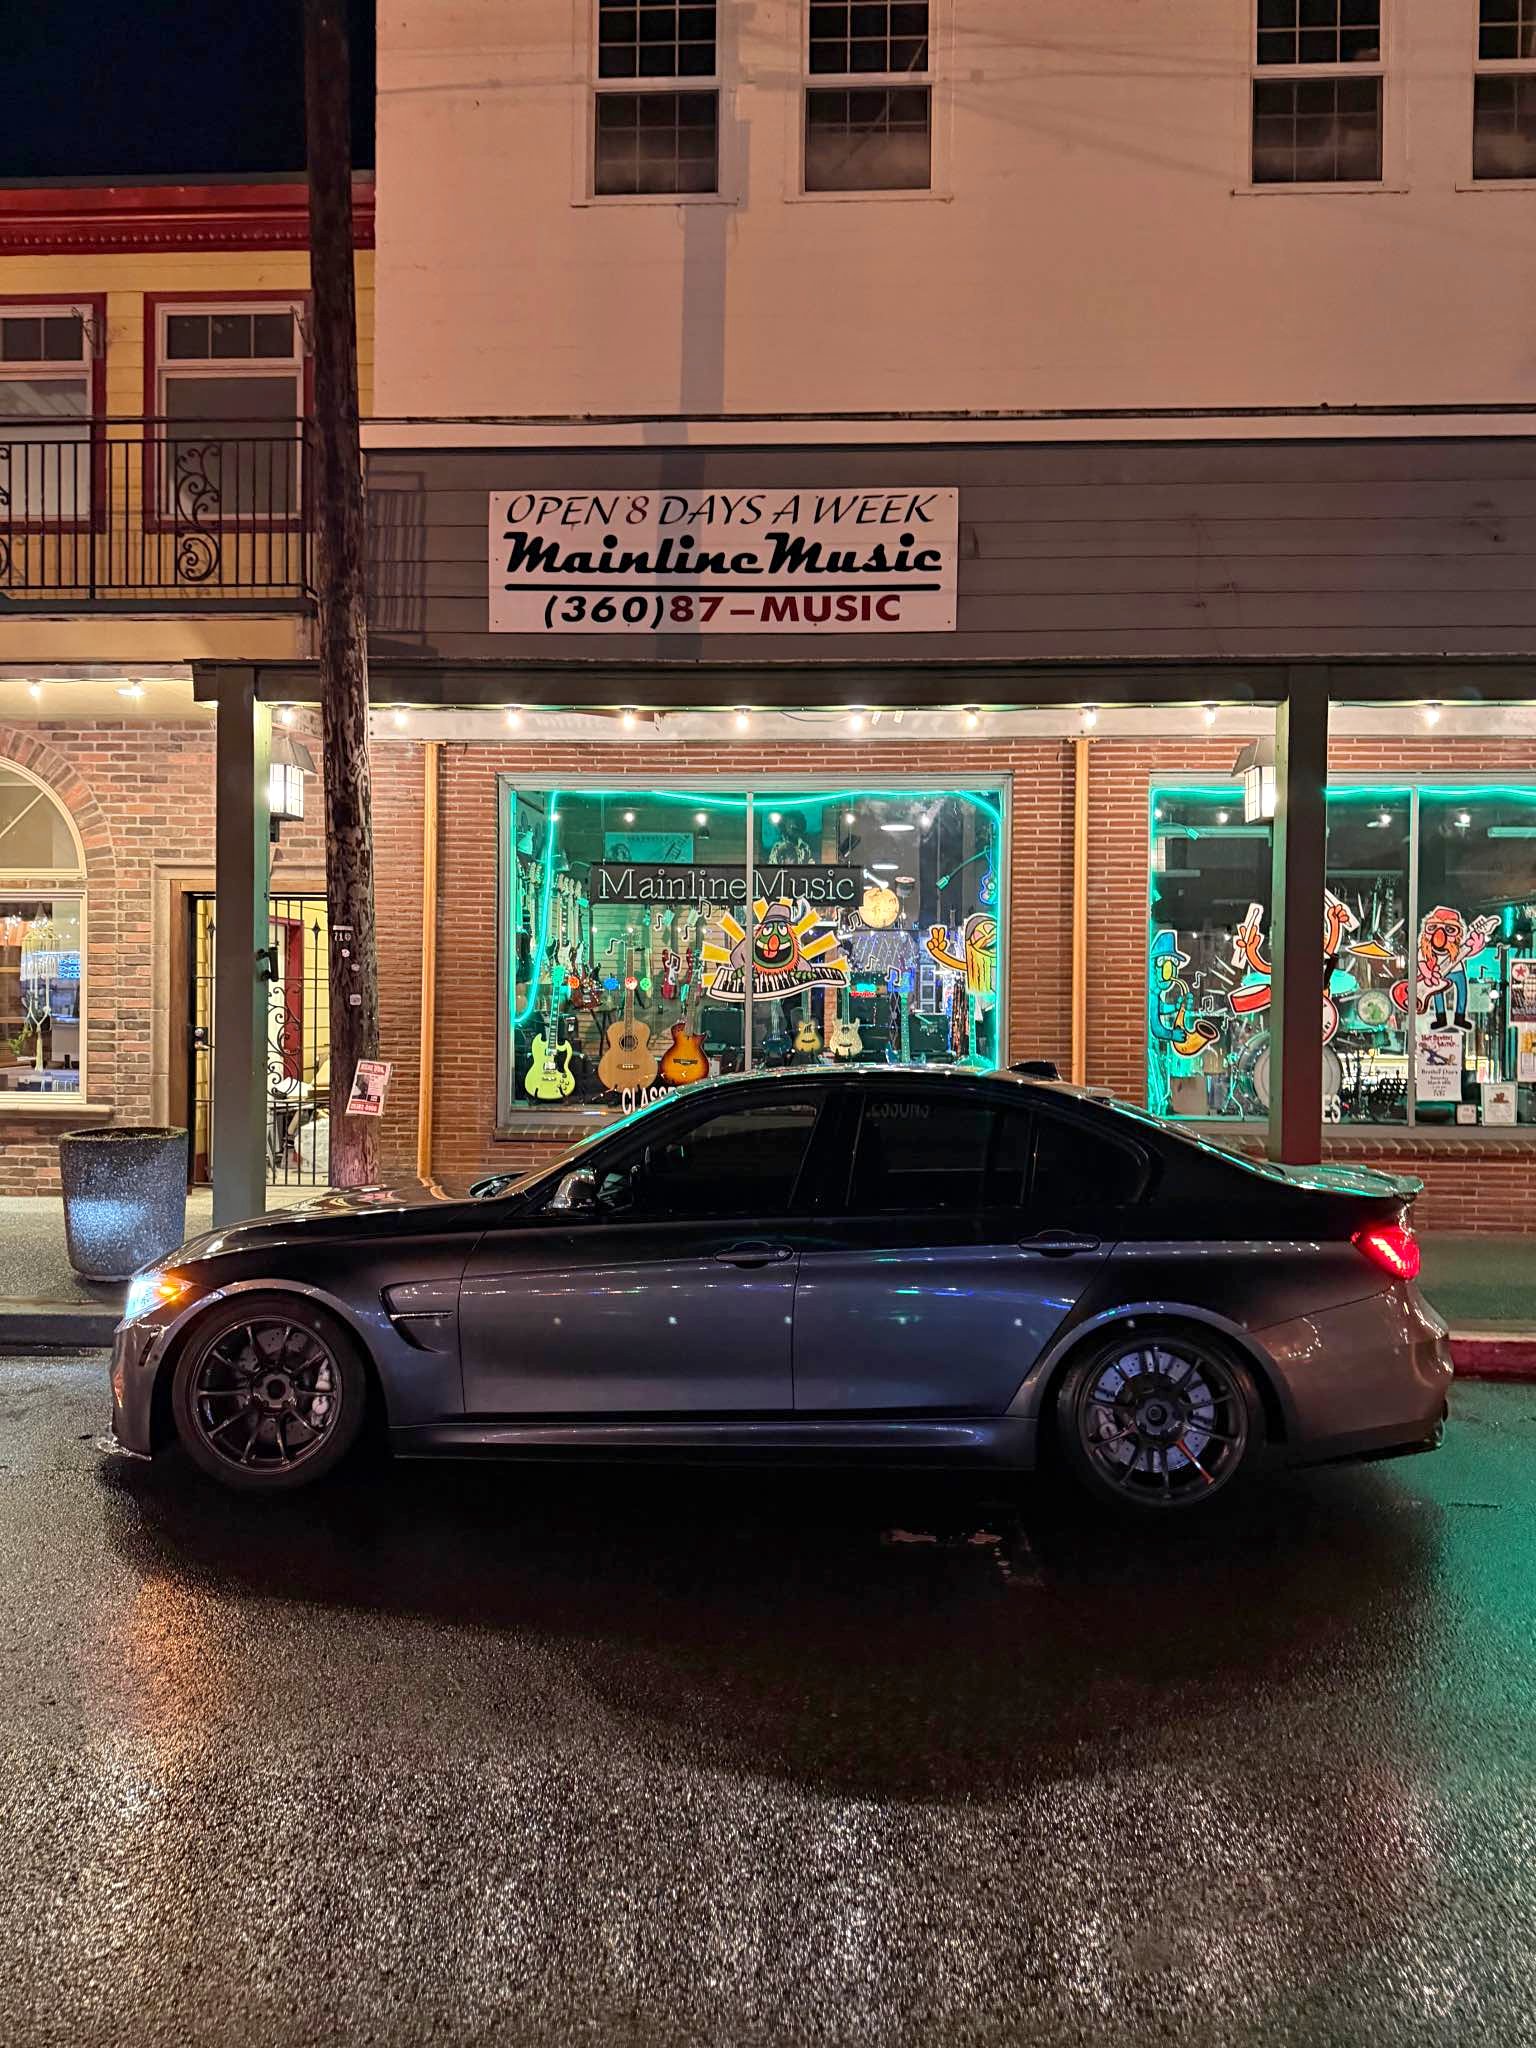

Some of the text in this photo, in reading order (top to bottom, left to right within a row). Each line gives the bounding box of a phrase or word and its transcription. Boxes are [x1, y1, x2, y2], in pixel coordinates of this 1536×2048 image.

[505, 493, 938, 528] OPEN 8 DAYS A WEEK
[503, 531, 943, 574] Mainline Music
[598, 867, 855, 900] Mainline Music
